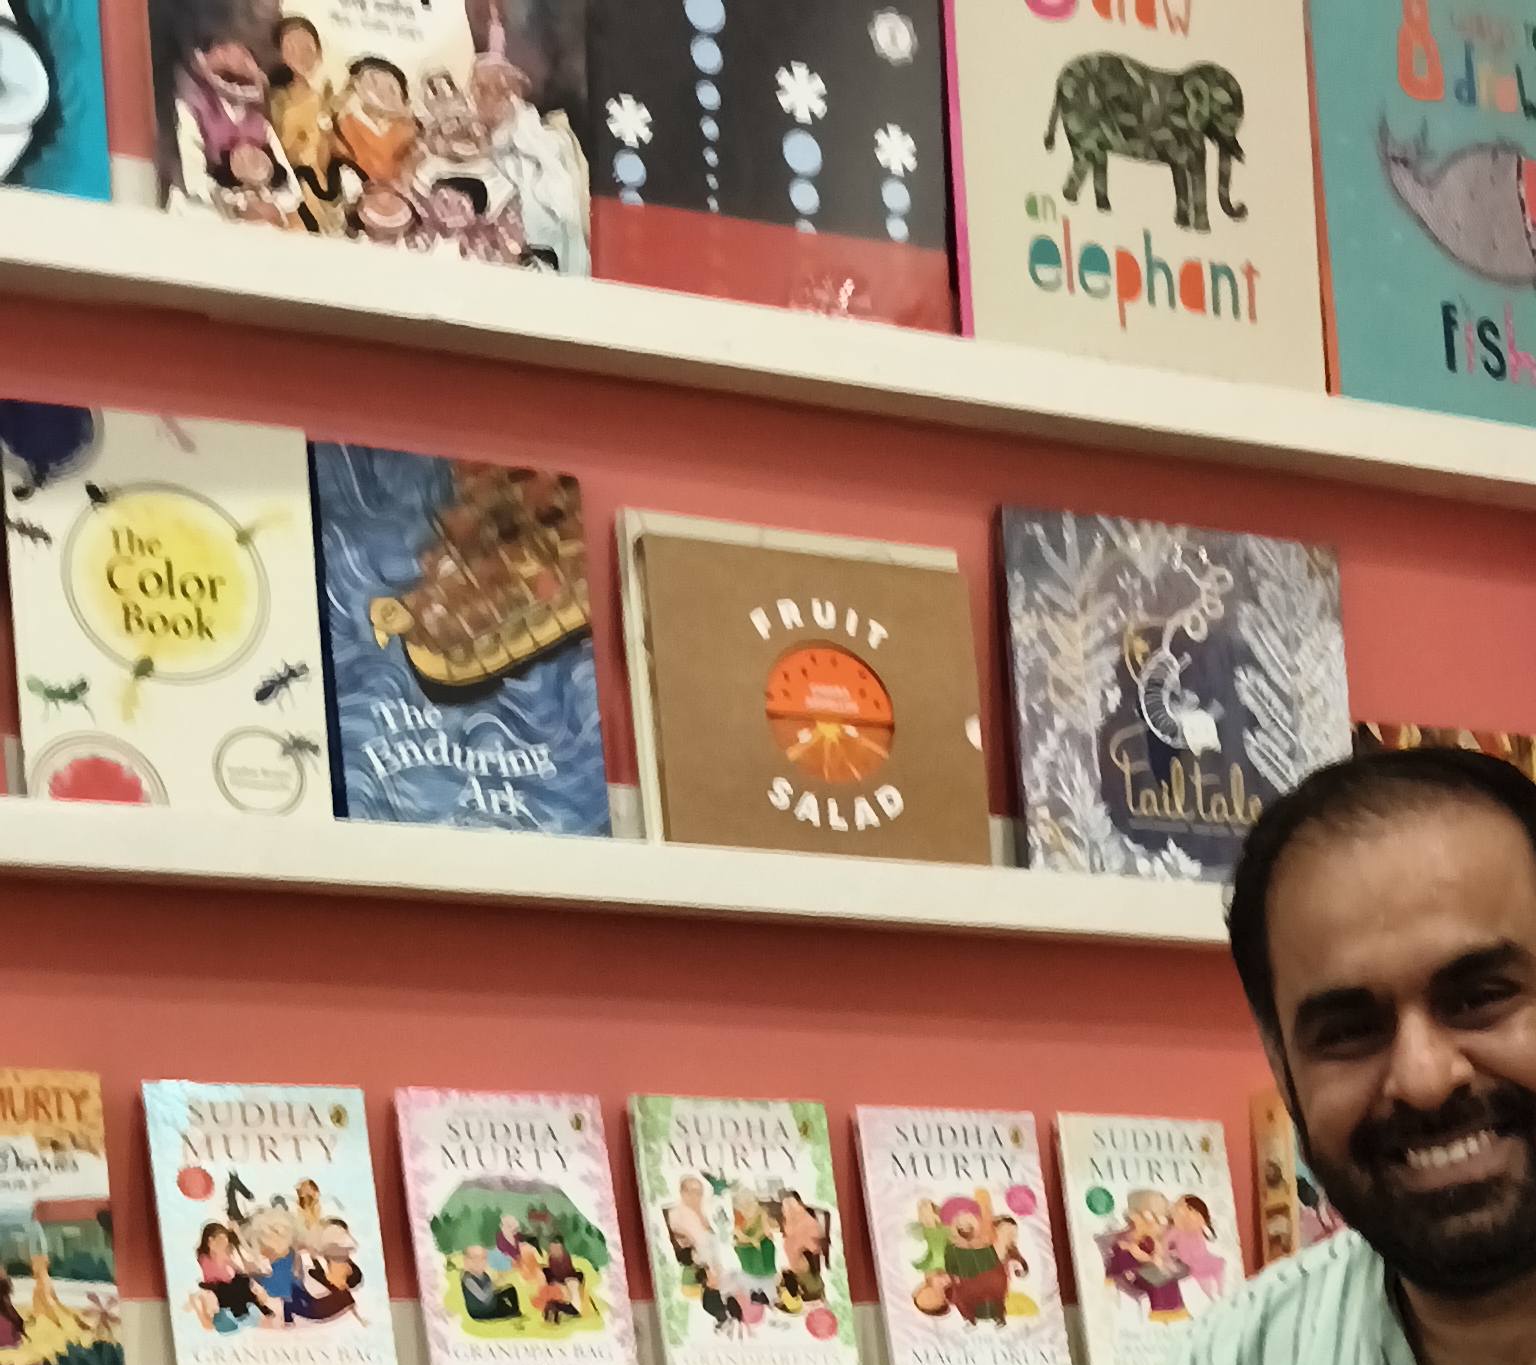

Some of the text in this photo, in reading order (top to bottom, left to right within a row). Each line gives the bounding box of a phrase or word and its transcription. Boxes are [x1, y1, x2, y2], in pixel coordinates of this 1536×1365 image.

[1025, 192, 1057, 223] an
[1027, 215, 1262, 329] elephant
[111, 527, 164, 557] The
[105, 553, 227, 604] Color
[121, 600, 218, 643] Book
[749, 597, 889, 650] FRUIT
[371, 697, 443, 735] The
[361, 735, 557, 780] Enduring
[459, 776, 531, 818] Ark
[767, 776, 905, 832] SALAD
[187, 1100, 323, 1129] SUDHA
[446, 1116, 560, 1143] SUDHA
[675, 1113, 790, 1140] SUDHA
[179, 1130, 338, 1164] MURTY
[895, 1123, 1003, 1149] SUDHA
[1093, 1129, 1194, 1154] SUDHA
[440, 1143, 573, 1171] MURTY
[667, 1141, 798, 1170] MURTY
[891, 1152, 1015, 1180] MURTY
[1090, 1156, 1204, 1184] MURTY
